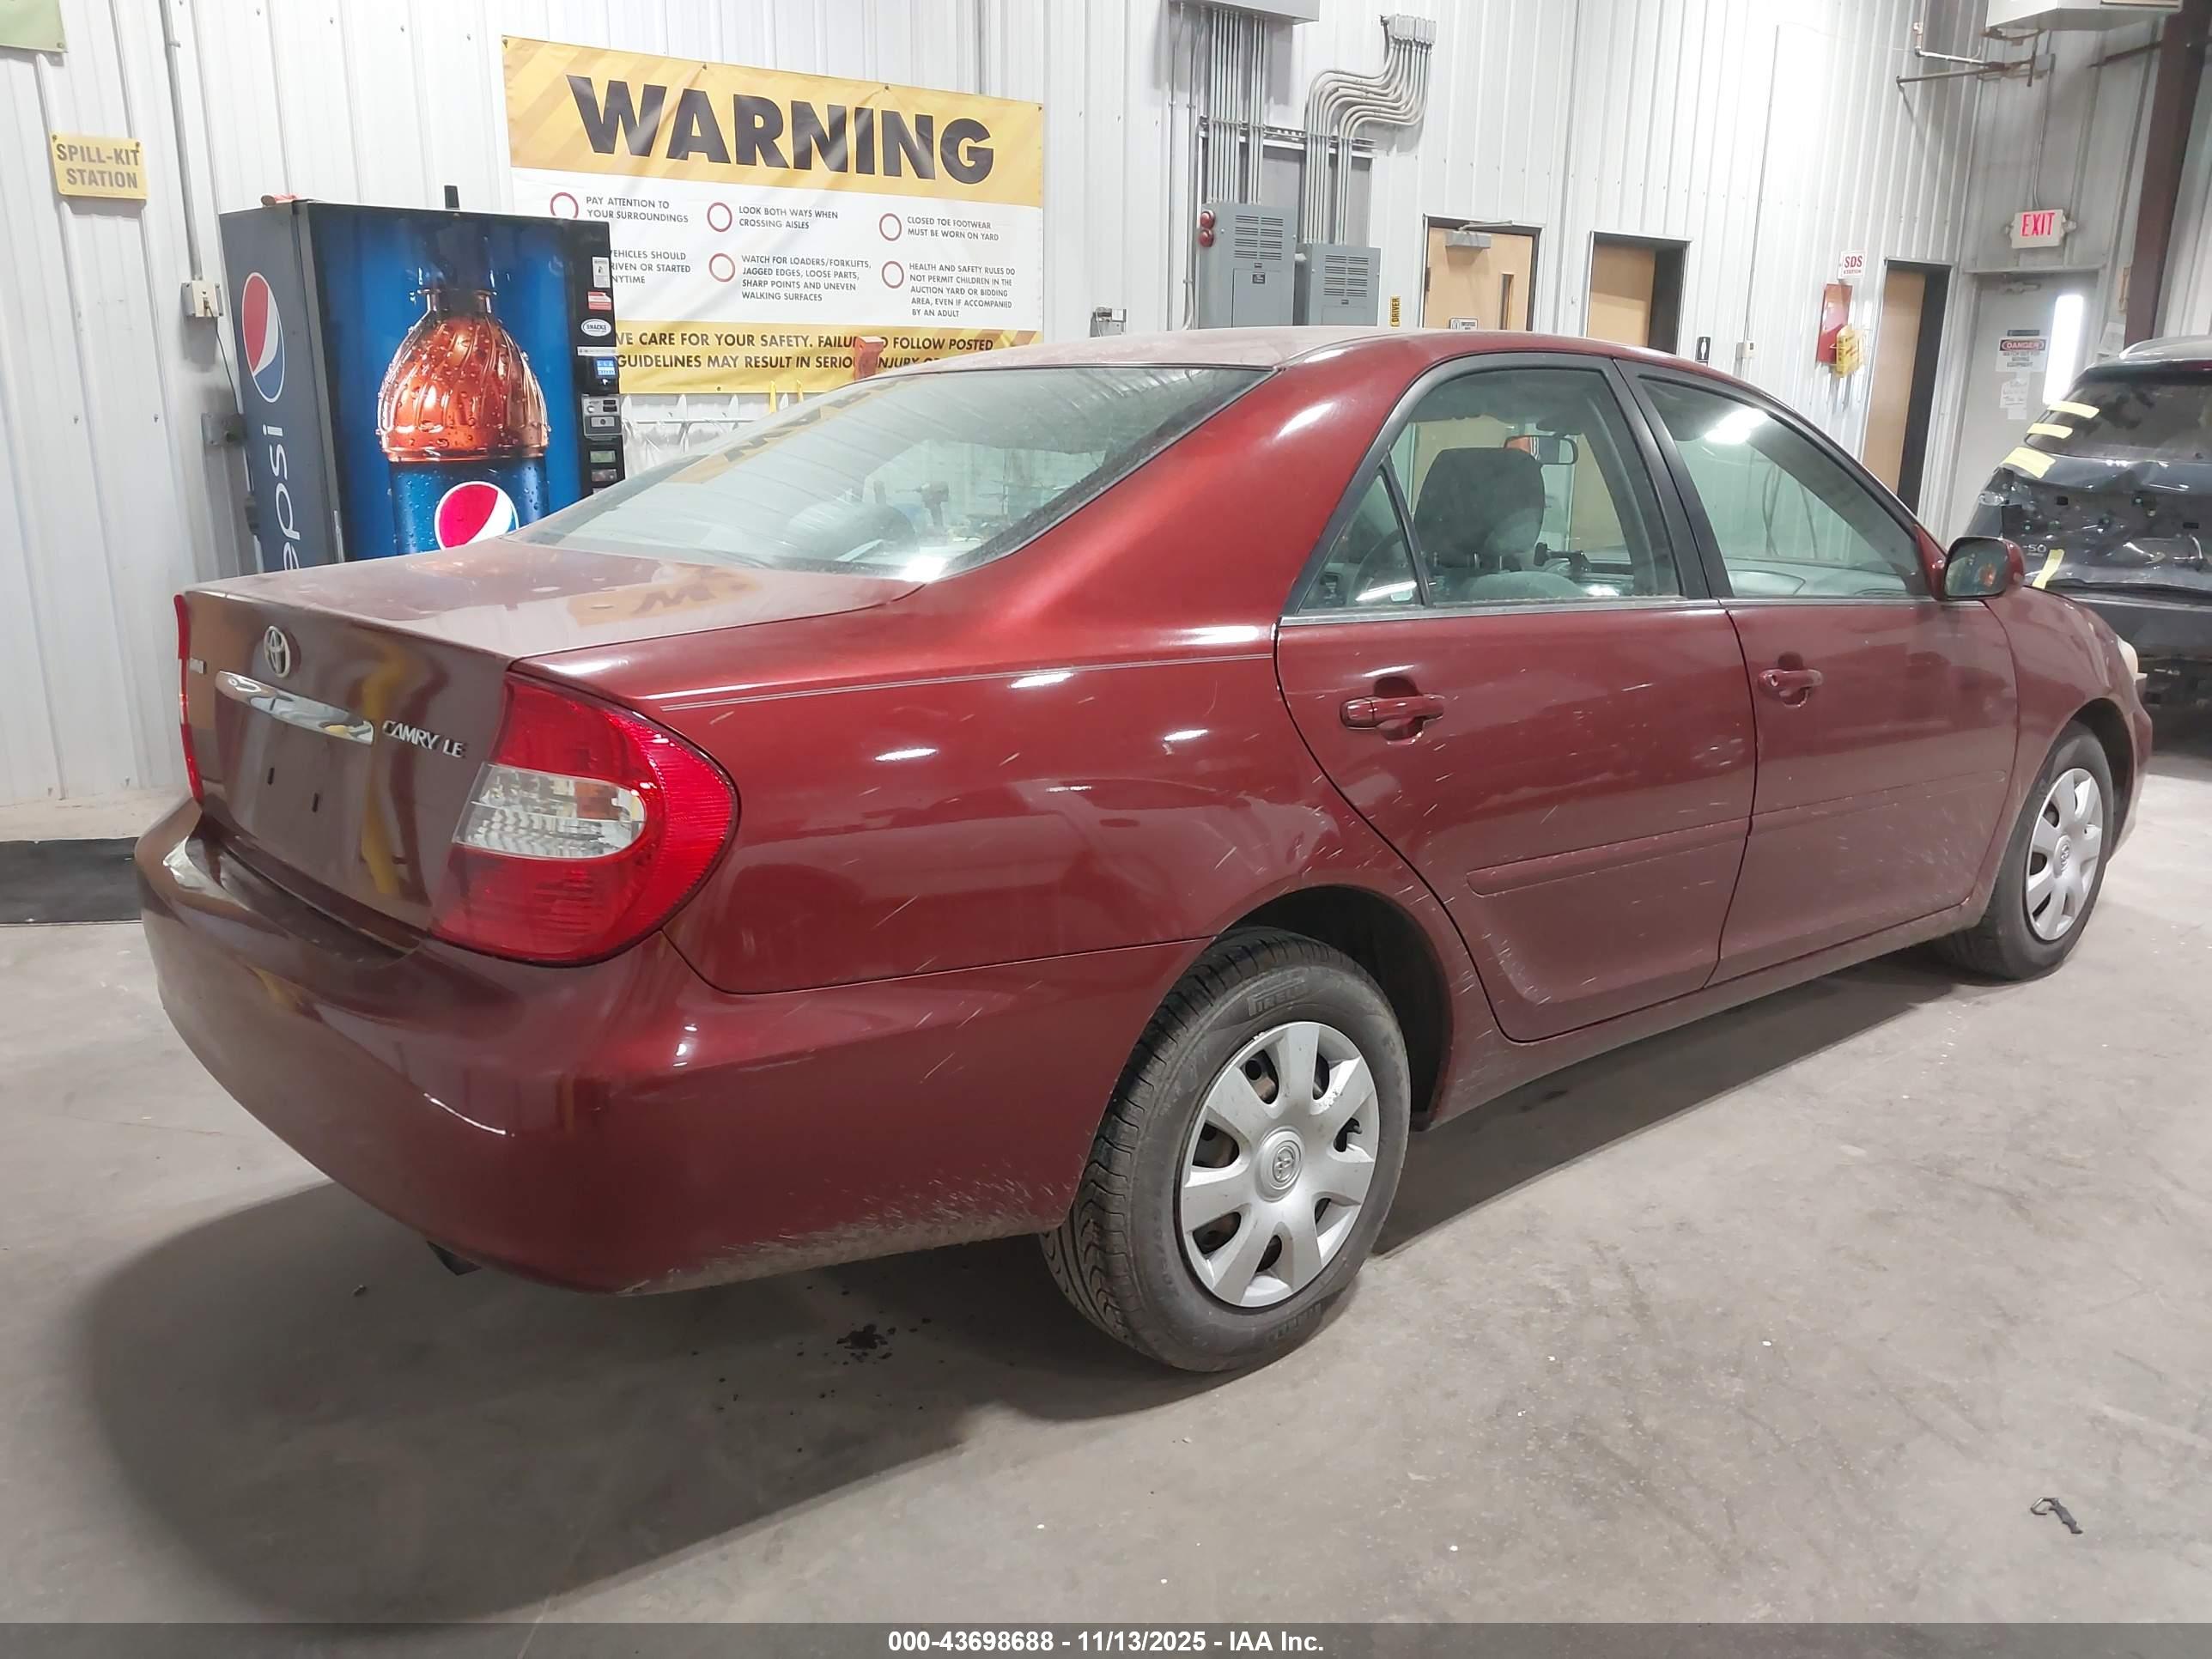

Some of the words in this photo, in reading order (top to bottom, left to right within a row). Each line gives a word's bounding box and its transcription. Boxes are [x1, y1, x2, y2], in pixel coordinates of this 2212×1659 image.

[567, 75, 994, 185] WARNING
[56, 143, 139, 166] SPILL-KIT
[66, 167, 138, 189] STATION
[586, 197, 604, 205] PAY
[607, 198, 655, 208] ATTENTION
[658, 200, 670, 209] TO
[587, 209, 614, 219] YOUR
[616, 210, 689, 223] SURROUNDINGS
[739, 205, 762, 215] LOOK
[764, 207, 787, 216] BOTH
[789, 209, 812, 218] WAYS
[814, 210, 839, 219] WHEN
[739, 218, 782, 228] CROSSING
[785, 220, 810, 229] AISLES
[907, 216, 935, 225] CLOSED
[937, 217, 951, 226] TOE
[953, 219, 991, 229] FOOTWEAR
[2021, 212, 2055, 236] EXIT
[908, 228, 927, 236] MUST
[941, 229, 965, 239] WORN
[967, 231, 979, 240] ON
[981, 233, 999, 241] YARD
[651, 251, 686, 260] SHOULD
[741, 254, 770, 264] WATCH
[772, 256, 787, 264] FOR
[790, 257, 872, 269] LOADERS/FORKLIFTS,
[1844, 255, 1863, 268] SDS
[611, 262, 637, 270] RIVEN
[640, 263, 653, 272] OR
[656, 264, 690, 273] STARTED
[742, 267, 773, 276] JAGGED
[775, 268, 804, 278] EDGES,
[805, 270, 831, 278] LOOSE
[834, 270, 860, 280] PARTS,
[909, 263, 936, 271] HEALTH
[939, 264, 956, 272] AND
[957, 264, 982, 274] SAFETY
[984, 266, 1004, 275] RULES
[1006, 267, 1015, 276] DO
[612, 275, 646, 284] NYTIME
[742, 279, 768, 288] SHARP
[770, 280, 801, 289] POINTS
[803, 281, 821, 289] AND
[823, 282, 856, 291] UNEVEN
[909, 274, 926, 283] NOT
[927, 275, 953, 283] PERMIT
[956, 276, 989, 285] CHILDREN
[742, 291, 781, 301] WALKING
[783, 292, 823, 301] SURFACES
[910, 286, 944, 295] AUCTION
[945, 287, 965, 295] YARD
[967, 288, 978, 296] OR
[980, 289, 1007, 297] BIDDING
[911, 297, 933, 307] AREA,
[935, 298, 954, 307] EVEN
[963, 299, 1012, 308] ACCOMPANIED
[639, 332, 676, 345] CARE
[681, 333, 709, 346] FOR
[714, 333, 755, 347] YOUR
[760, 334, 813, 348] SAFETY.
[818, 335, 857, 348] FAILU
[893, 337, 945, 350] FOLLOW
[948, 337, 994, 351] POSTED
[617, 354, 702, 368] GUIDELINES
[707, 356, 739, 368] MAY
[744, 356, 793, 368] RESULT
[795, 356, 811, 368] IN
[816, 356, 855, 368] SERIO
[263, 424, 301, 570] epsi
[382, 720, 441, 750] CAMRY
[442, 738, 464, 757] LE
